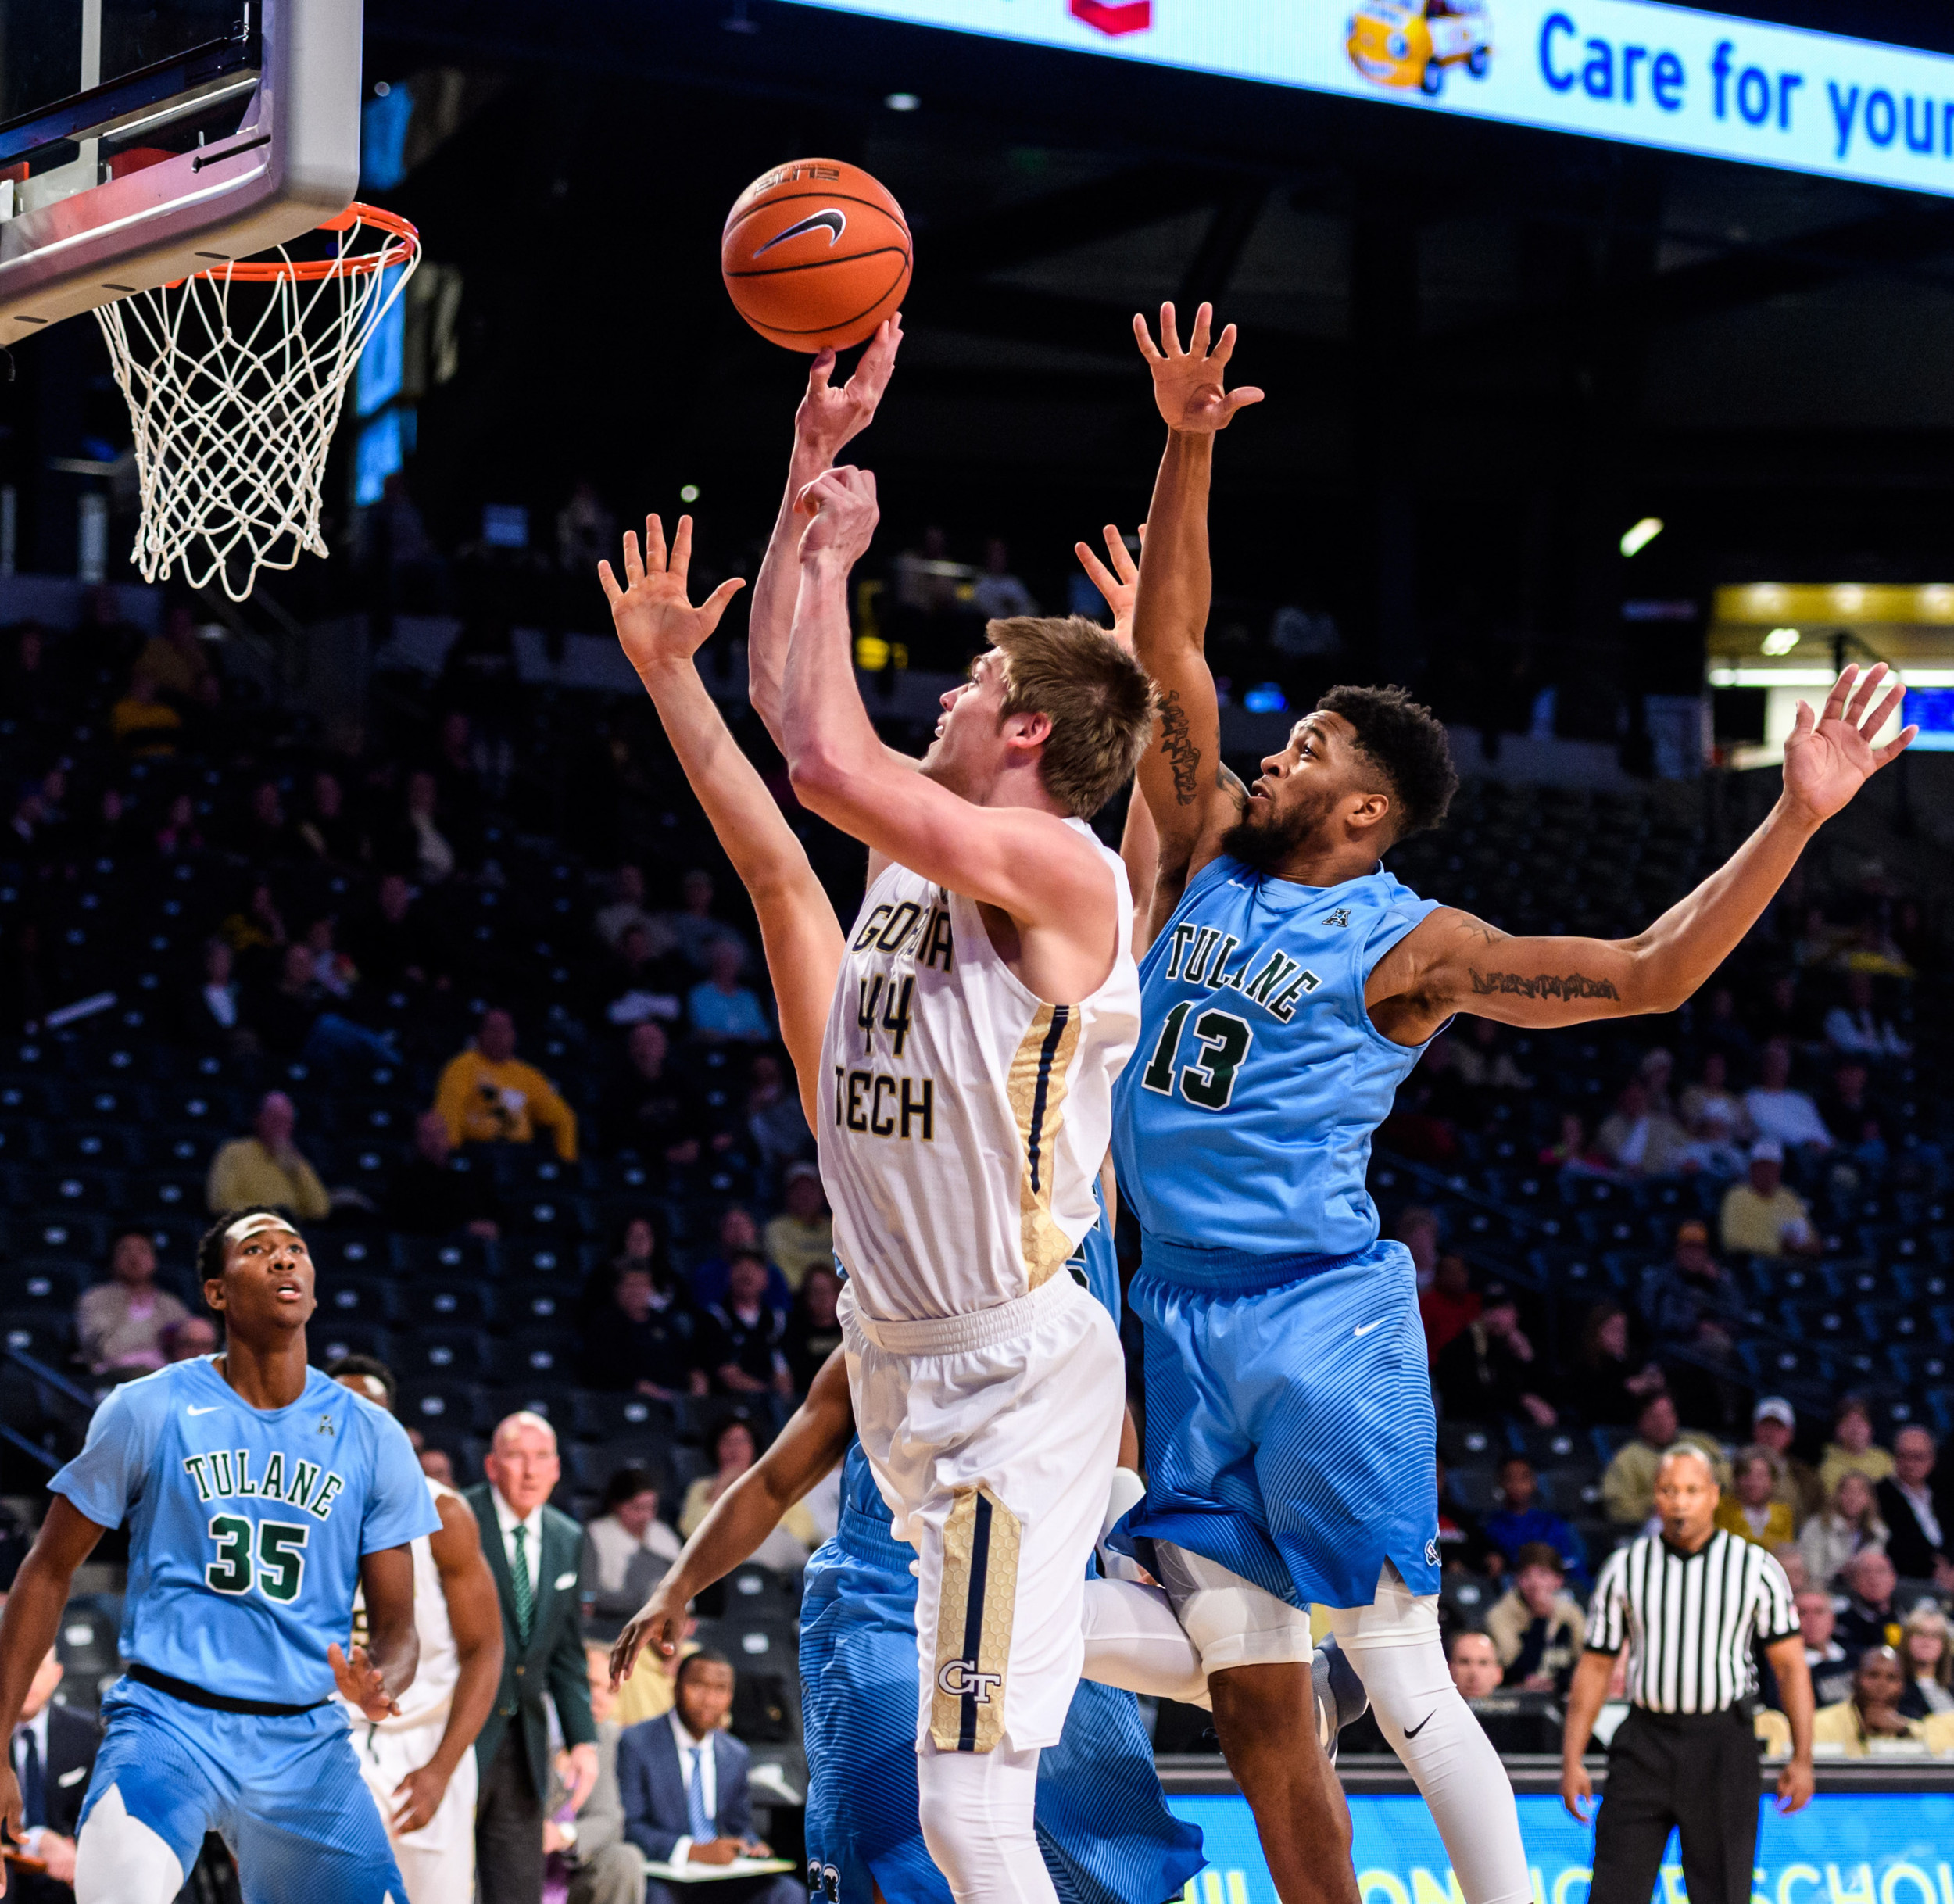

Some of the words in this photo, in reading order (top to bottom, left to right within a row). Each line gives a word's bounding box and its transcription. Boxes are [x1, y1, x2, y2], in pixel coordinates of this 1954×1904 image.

[1538, 11, 1684, 113] Care
[1709, 40, 1803, 131] for
[857, 973, 916, 1058] 44
[1141, 1000, 1254, 1111] 13
[182, 1449, 345, 1522] TULANE
[205, 1512, 310, 1605] 35
[938, 1659, 1001, 1703] GT
